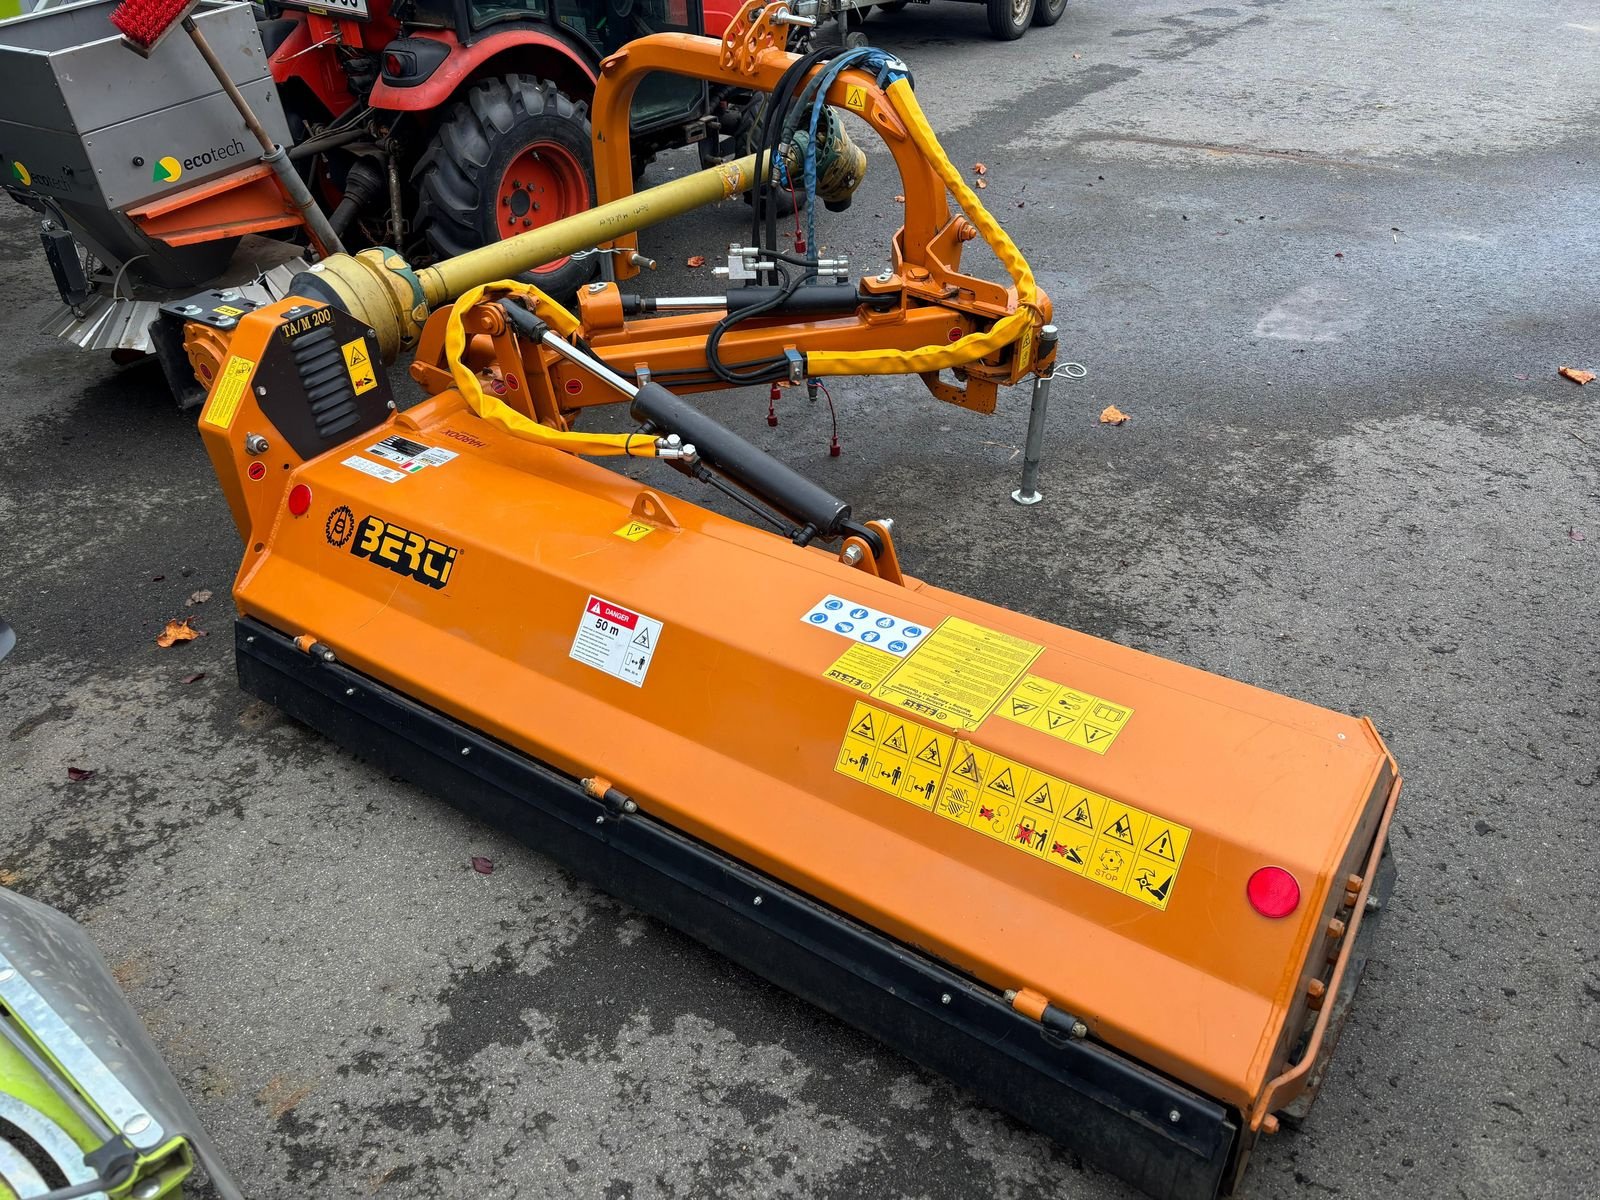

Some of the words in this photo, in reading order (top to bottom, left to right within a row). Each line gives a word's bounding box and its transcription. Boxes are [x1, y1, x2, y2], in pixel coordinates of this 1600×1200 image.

[183, 138, 246, 171] ecotech
[32, 172, 73, 193] ecotech
[281, 316, 311, 338] TA/M
[313, 309, 332, 326] 200
[443, 429, 486, 448] HARDOX
[605, 608, 630, 622] DANGER
[595, 618, 608, 632] 50
[609, 625, 620, 637] m
[1094, 868, 1118, 882] STOP
